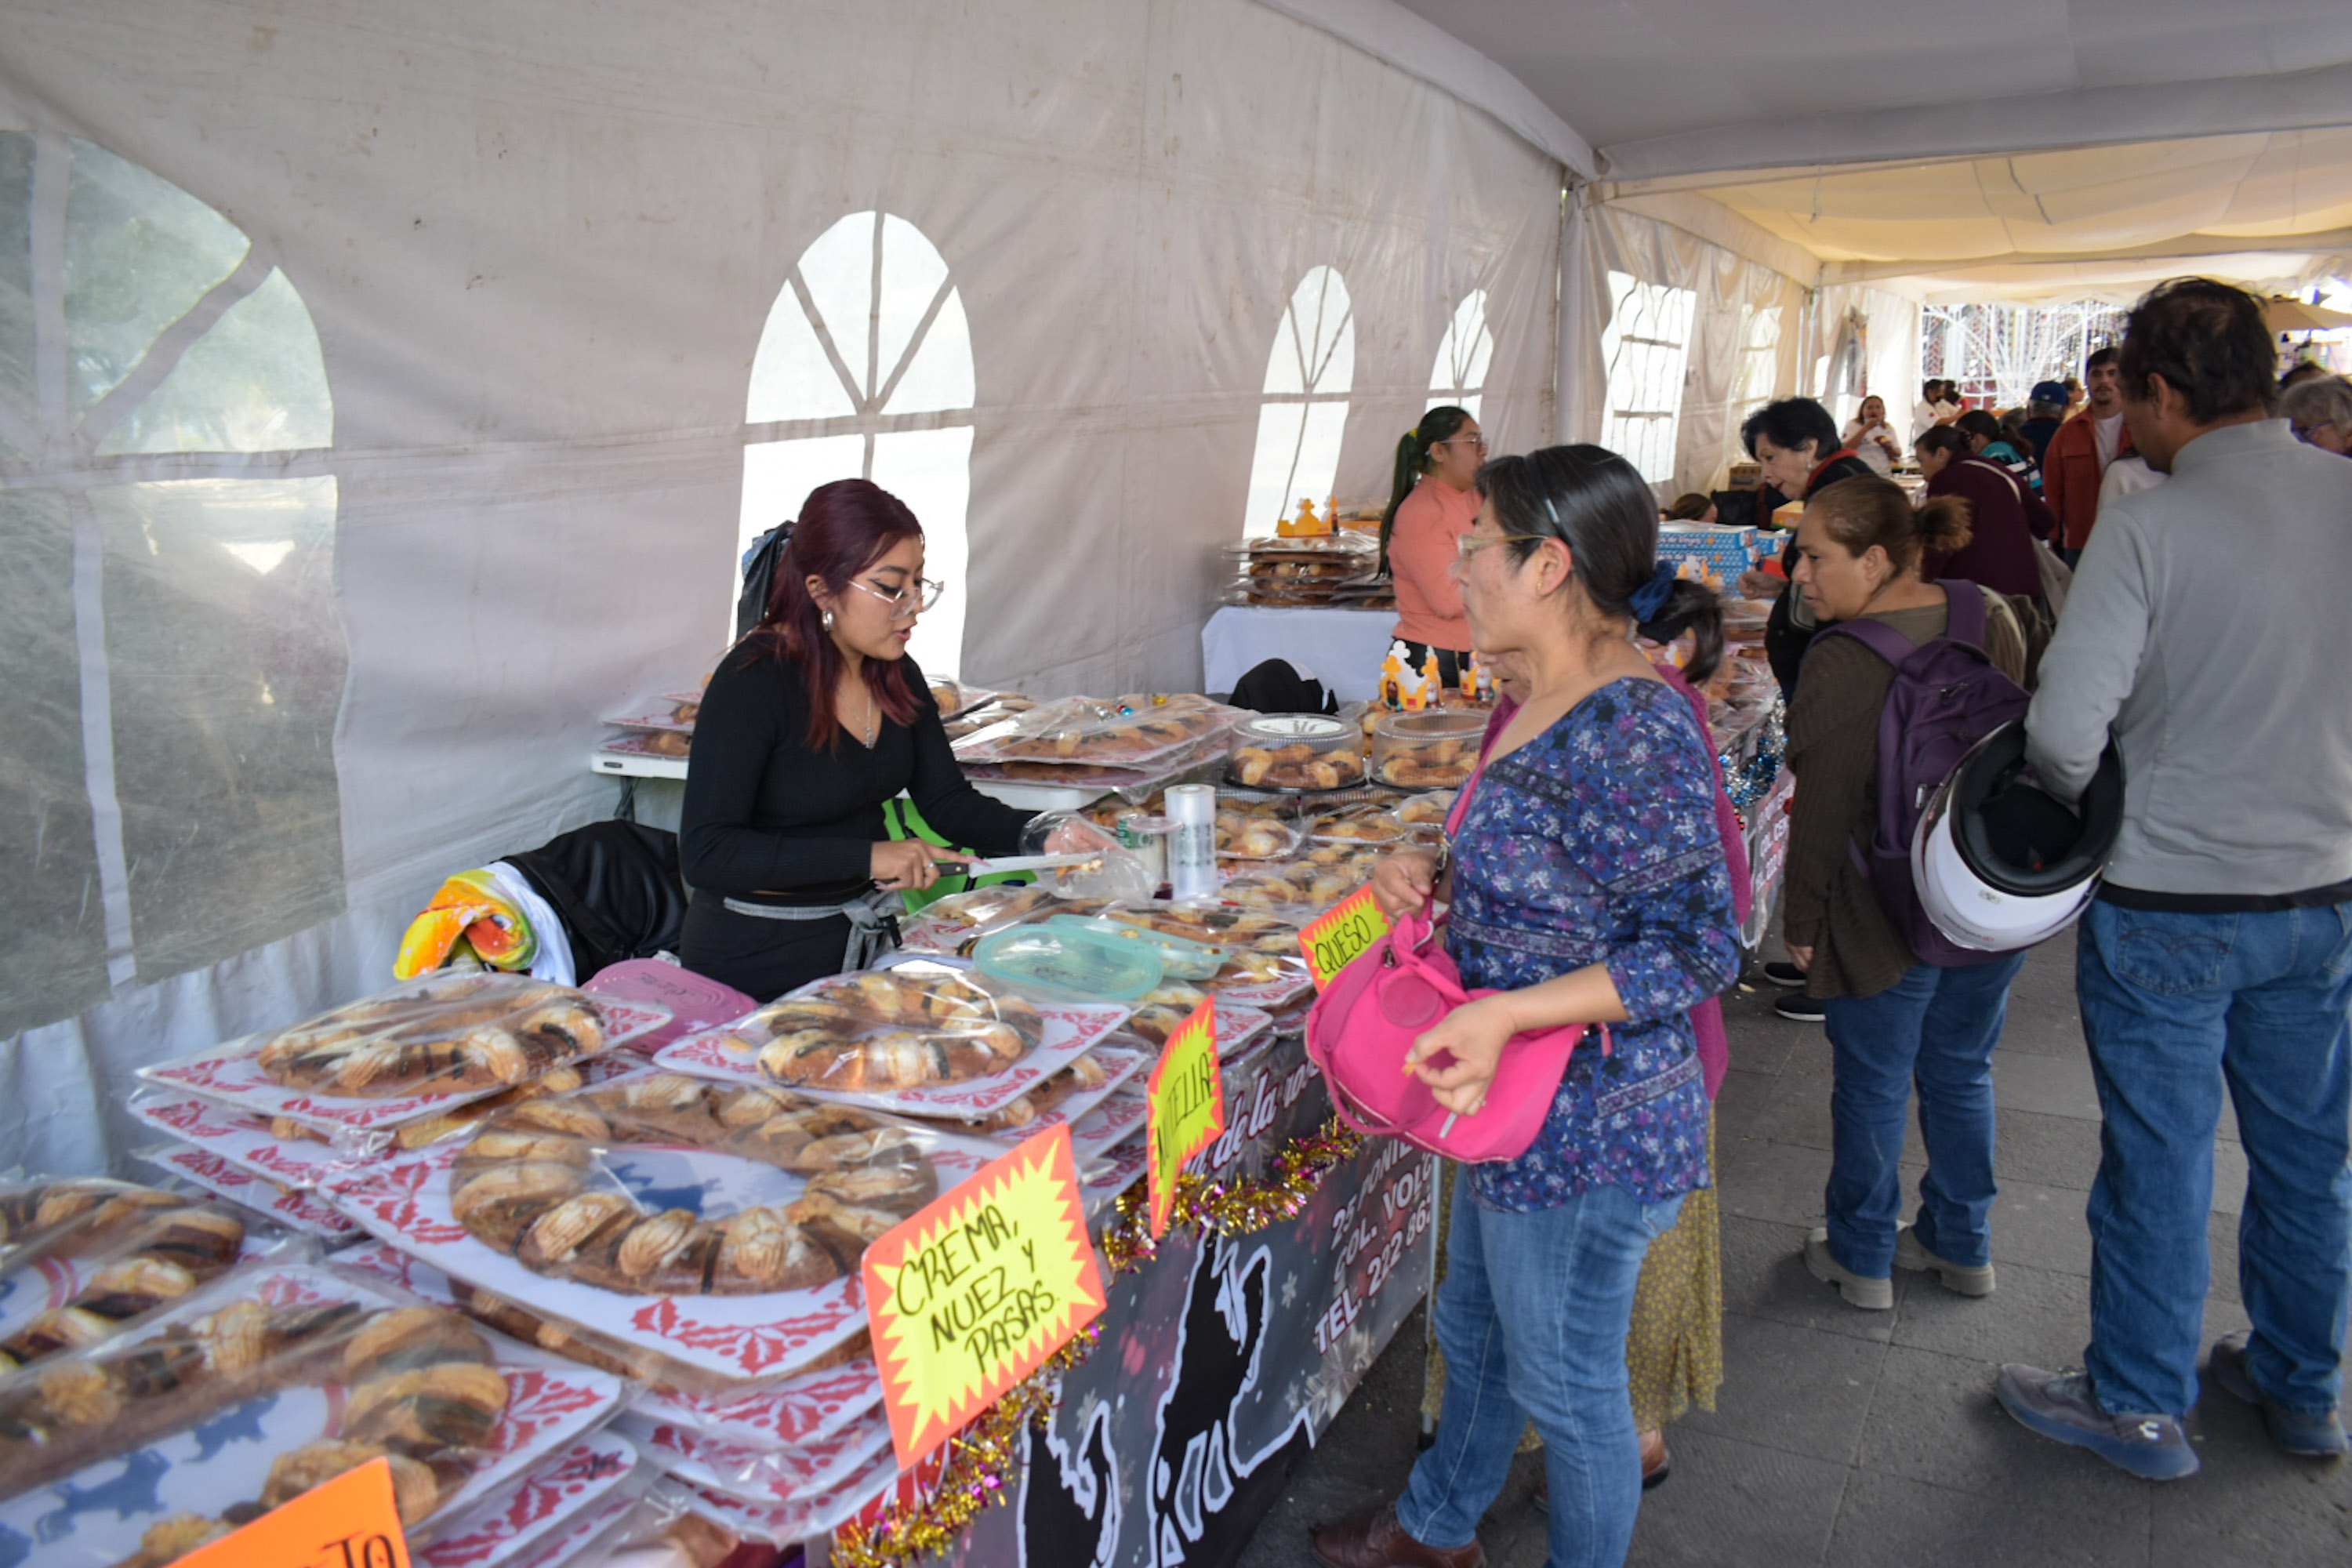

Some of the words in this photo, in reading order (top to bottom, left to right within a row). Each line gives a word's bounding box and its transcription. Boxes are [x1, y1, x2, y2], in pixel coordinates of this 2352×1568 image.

[1315, 913, 1372, 975] QUESO
[1212, 1091, 1249, 1169] de
[1248, 1069, 1280, 1138] la
[896, 1204, 1018, 1316] CREMA,
[1330, 1192, 1357, 1251] 25
[1334, 1217, 1378, 1284] COL.
[930, 1265, 1017, 1353] NUEZ
[1021, 1238, 1036, 1274] Y
[1315, 1285, 1363, 1356] TEL.
[1367, 1230, 1403, 1298] 222
